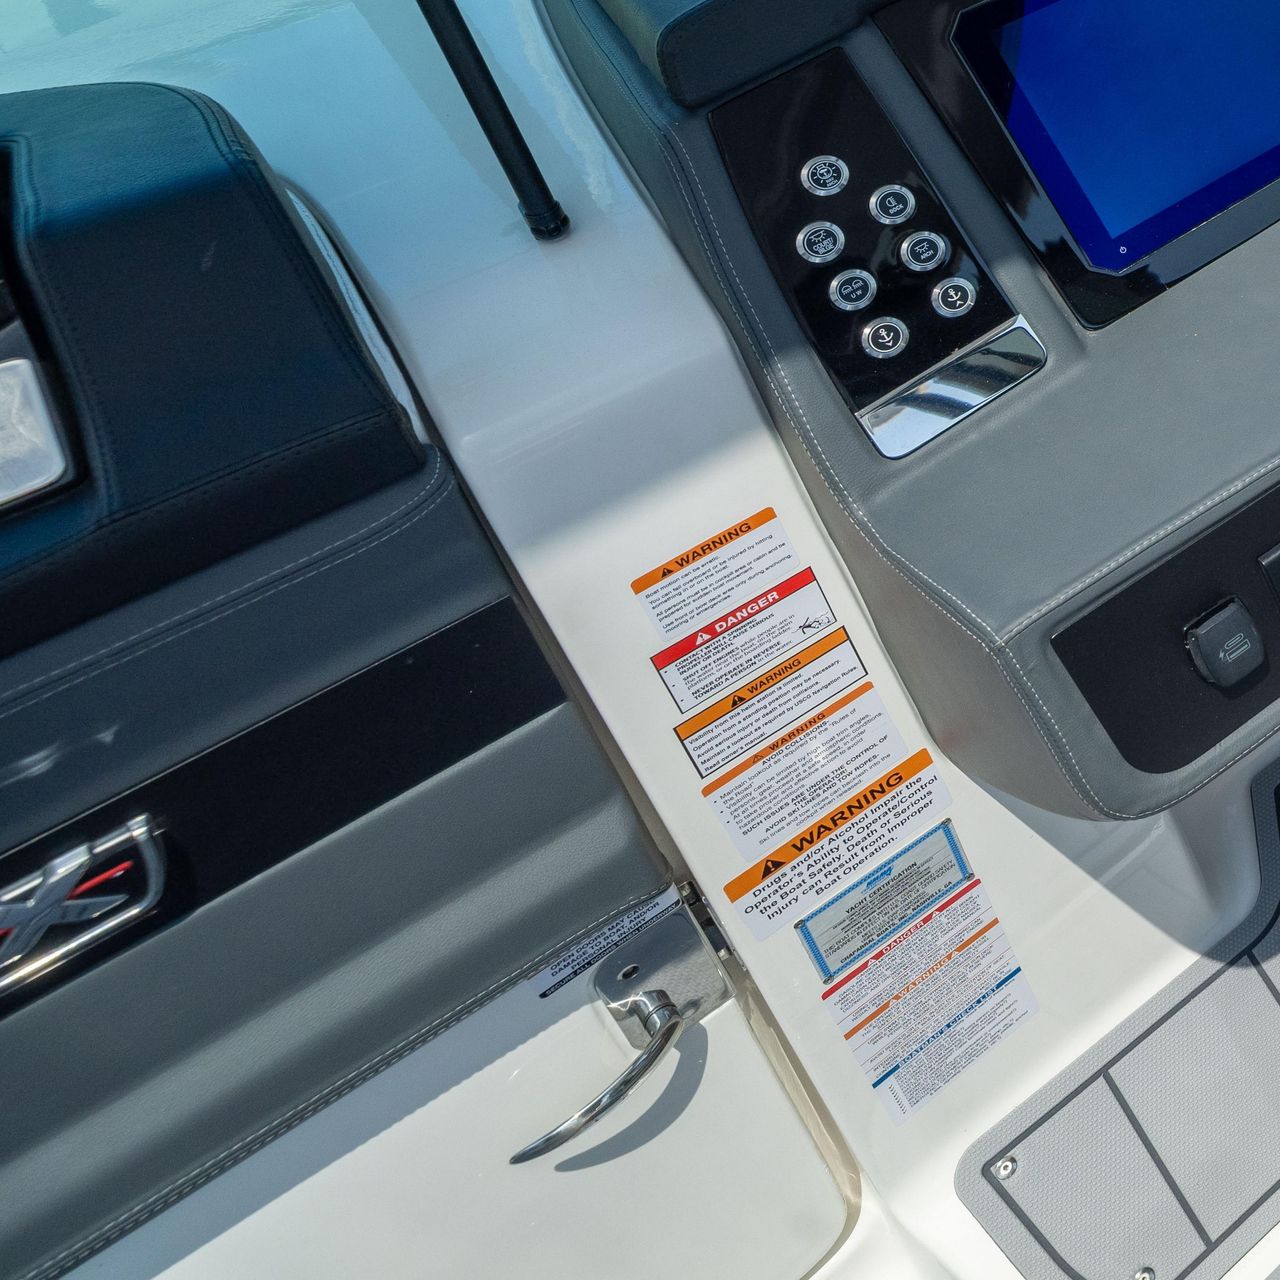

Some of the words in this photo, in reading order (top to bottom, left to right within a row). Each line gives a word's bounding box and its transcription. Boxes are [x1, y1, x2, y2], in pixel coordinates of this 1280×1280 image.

[889, 204, 903, 214] DOCK
[920, 250, 934, 260] ARCH
[674, 521, 751, 569] WARNING
[714, 590, 779, 632] DANGER
[692, 731, 722, 752] Operation
[722, 722, 736, 733] from
[741, 703, 767, 722] standing
[767, 689, 791, 706] position
[791, 681, 803, 691] may
[811, 658, 840, 678] necessary.
[746, 657, 801, 695] WARNING
[688, 727, 714, 745] Visibility
[714, 718, 728, 729] from
[728, 710, 740, 720] this
[740, 701, 755, 712] helm
[756, 689, 776, 703] station
[782, 672, 802, 687] limited.
[696, 745, 714, 759] Avoid
[714, 732, 736, 747] serious
[736, 721, 754, 734] injury
[761, 705, 778, 718] death
[778, 697, 792, 708] from
[792, 679, 820, 699] collisions.
[700, 747, 725, 765] Maintain
[731, 730, 753, 746] lookout
[761, 710, 786, 727] required
[793, 693, 811, 707] USCG
[811, 675, 841, 696] Navigation
[841, 664, 858, 677] Rules.
[768, 711, 825, 751] WARNING
[704, 759, 720, 772] Read
[720, 745, 743, 762] owner's
[744, 730, 767, 747] manual.
[761, 748, 784, 765] AVOID
[752, 870, 788, 898] Drugs
[788, 843, 825, 871] and/or
[826, 812, 868, 845] Alcohol
[870, 788, 904, 815] Impair
[905, 775, 922, 790] the
[790, 770, 903, 855] WARNING
[743, 869, 804, 915] Operator's
[804, 843, 841, 872] Ability
[842, 833, 854, 845] to
[855, 774, 937, 835] Operate/Control
[758, 898, 778, 915] the
[779, 877, 807, 900] Boat
[807, 850, 845, 880] Safely.
[846, 826, 877, 852] Death
[879, 818, 891, 829] or
[893, 788, 932, 819] Serious
[767, 894, 800, 921] Injury
[801, 878, 822, 895] can
[823, 850, 858, 879] Result
[859, 831, 885, 853] from
[887, 798, 934, 834] Improper
[815, 873, 841, 895] Boat
[842, 833, 897, 876] Operation.
[545, 972, 574, 996] SECURE
[576, 961, 590, 974] ALL
[590, 944, 614, 965] DOORS
[616, 928, 638, 947] WHEN
[639, 903, 676, 931] UNDERWAY
[550, 951, 574, 971] OPEN
[576, 929, 606, 954] DOORS
[607, 917, 624, 932] MAY
[551, 948, 588, 977] DAMAGE
[590, 940, 601, 951] TO
[603, 922, 627, 942] BOAT,
[629, 900, 659, 925] AND/OR
[571, 937, 615, 971] PERSONAL
[617, 915, 647, 939] INJURY
[881, 919, 924, 954] DANGER
[898, 955, 949, 998] WARNING
